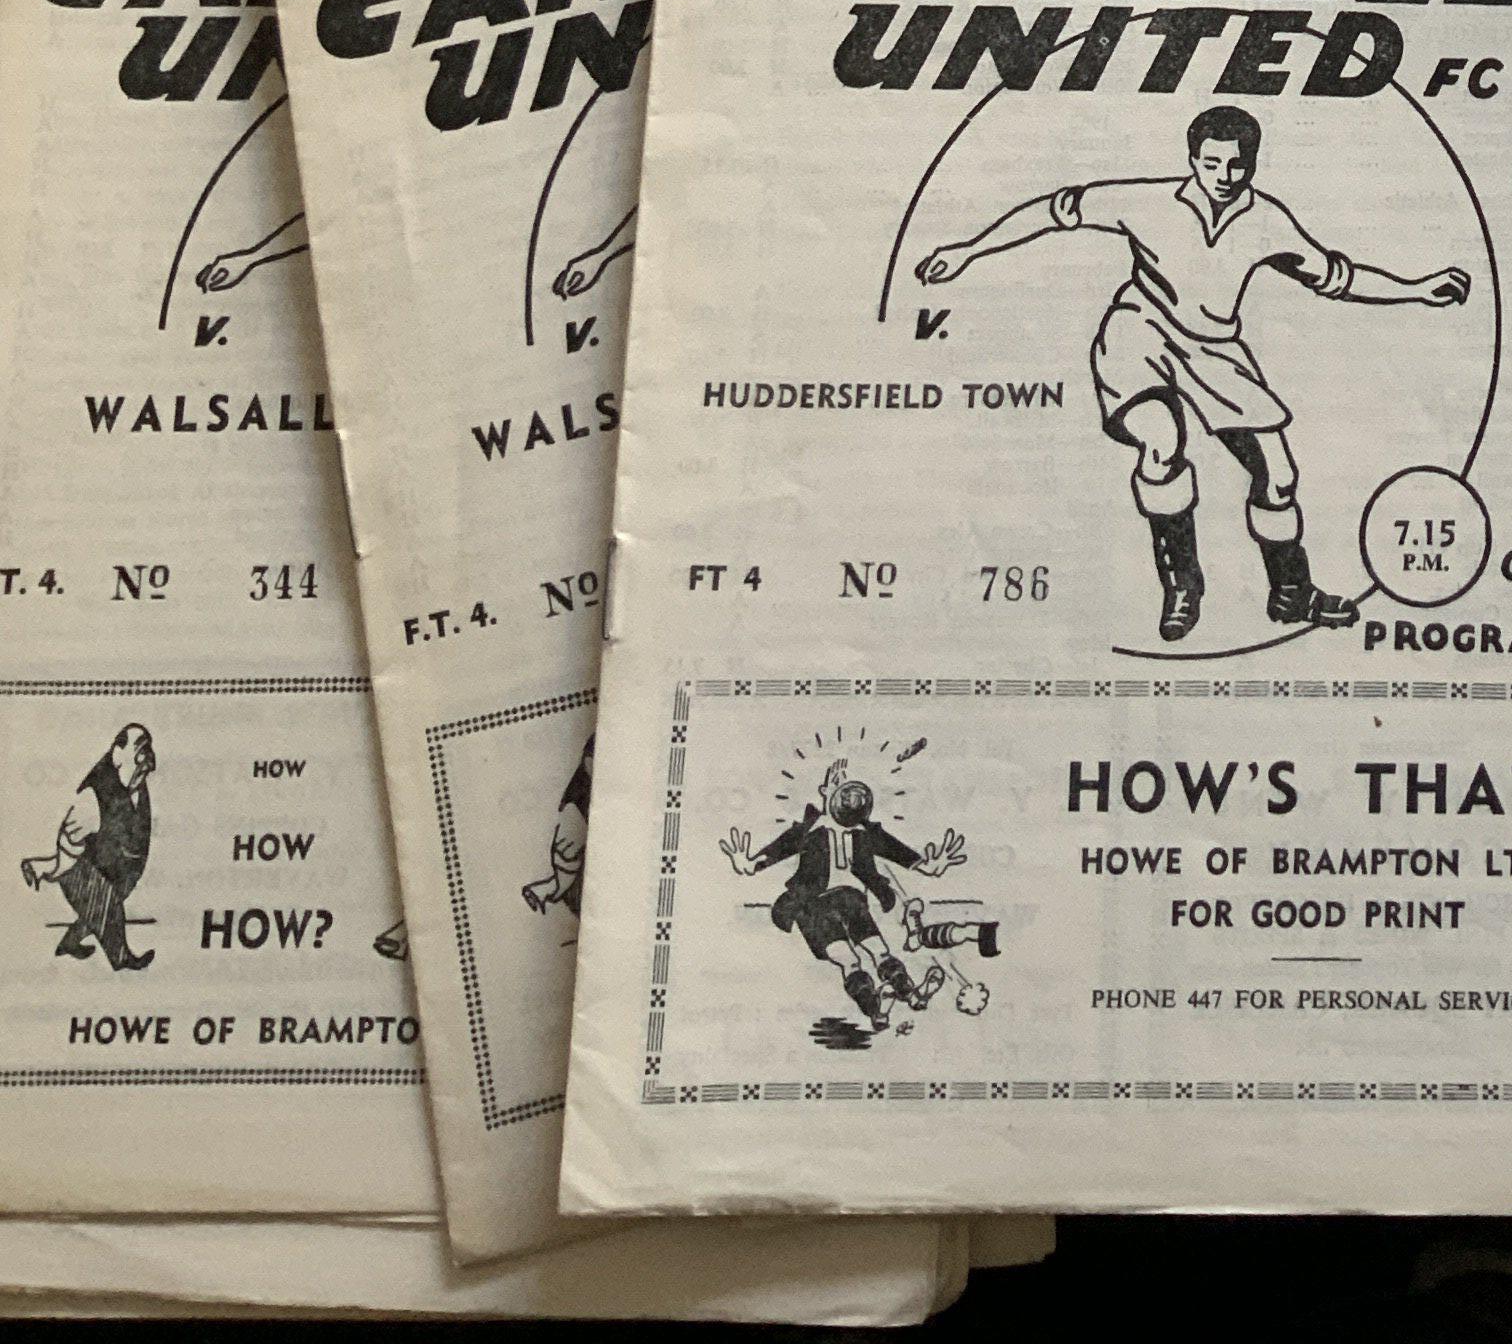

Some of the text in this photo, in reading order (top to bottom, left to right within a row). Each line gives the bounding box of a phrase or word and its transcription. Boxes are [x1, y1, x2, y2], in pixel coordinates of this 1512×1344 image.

[833, 4, 1403, 97] UNITED
[704, 382, 1063, 409] HUDDERSFIELD TOWN
[1394, 520, 1455, 547] 7.15
[250, 563, 318, 600] 344
[981, 566, 1049, 601] 786
[254, 760, 306, 778] HOW
[1068, 761, 1297, 815] HOW'S
[233, 833, 314, 861] HOW
[1273, 848, 1459, 877] BRAMPTON
[201, 908, 333, 949] HOW?
[1252, 900, 1465, 929] GOOD PRINT
[1092, 990, 1176, 1008] PHONE
[1188, 990, 1222, 1009] 447
[1297, 990, 1427, 1010] PERSONAL
[69, 1016, 235, 1045] HOWE OF
